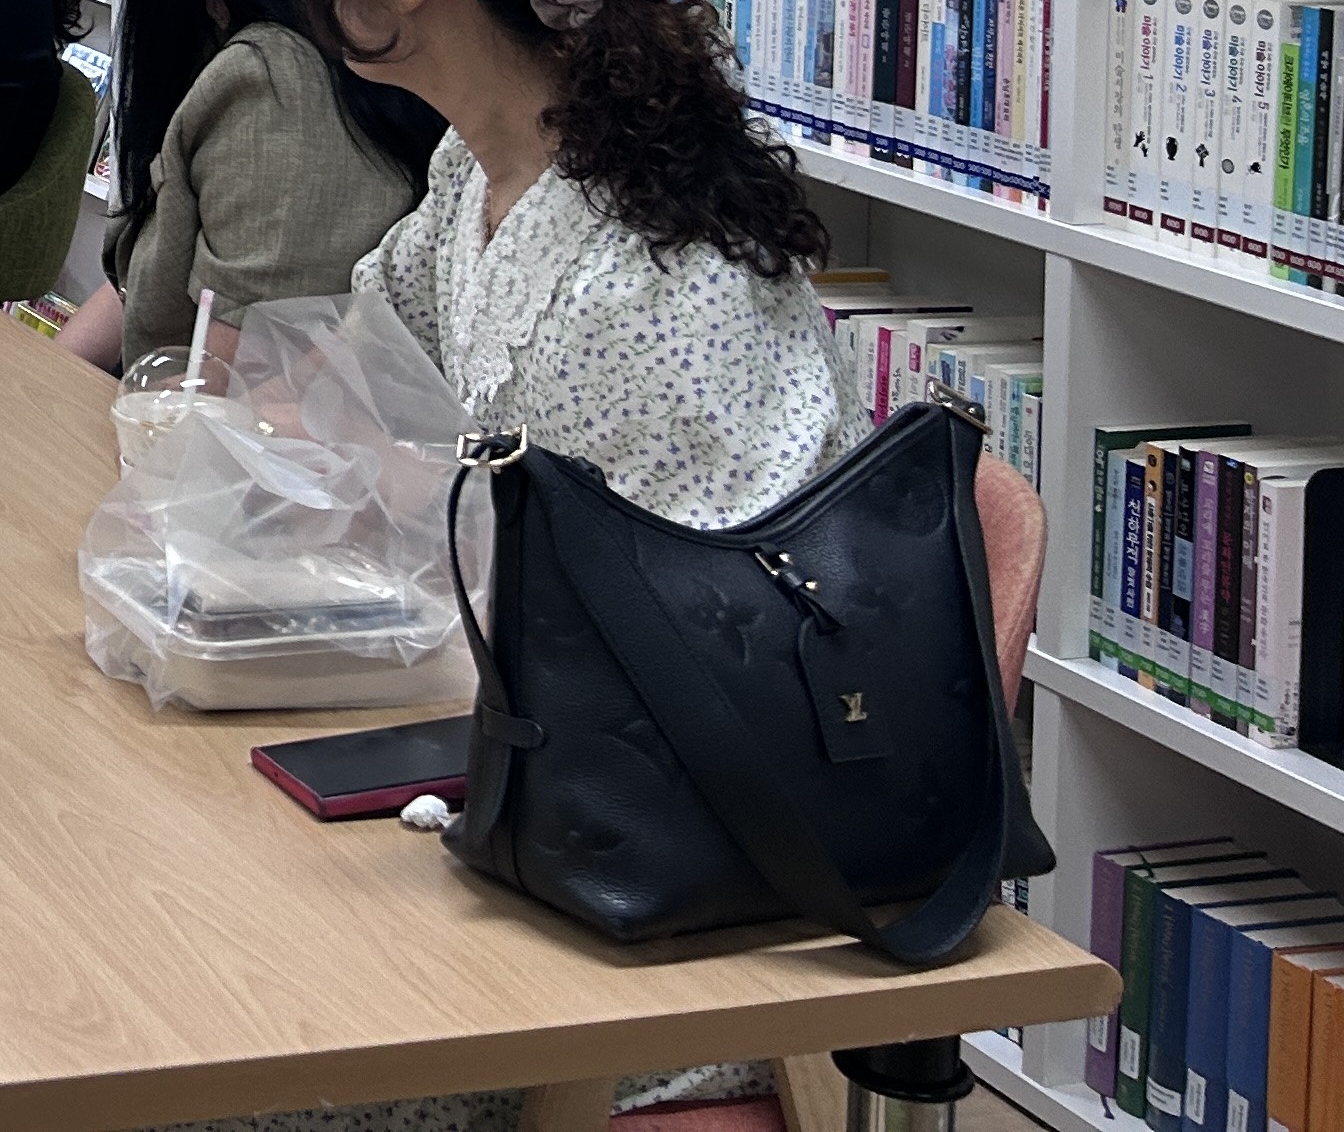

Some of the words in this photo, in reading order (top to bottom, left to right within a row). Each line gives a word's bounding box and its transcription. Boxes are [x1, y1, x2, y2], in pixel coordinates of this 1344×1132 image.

[1176, 84, 1187, 92] 2
[1231, 95, 1242, 103] 4
[1257, 102, 1269, 110] 5
